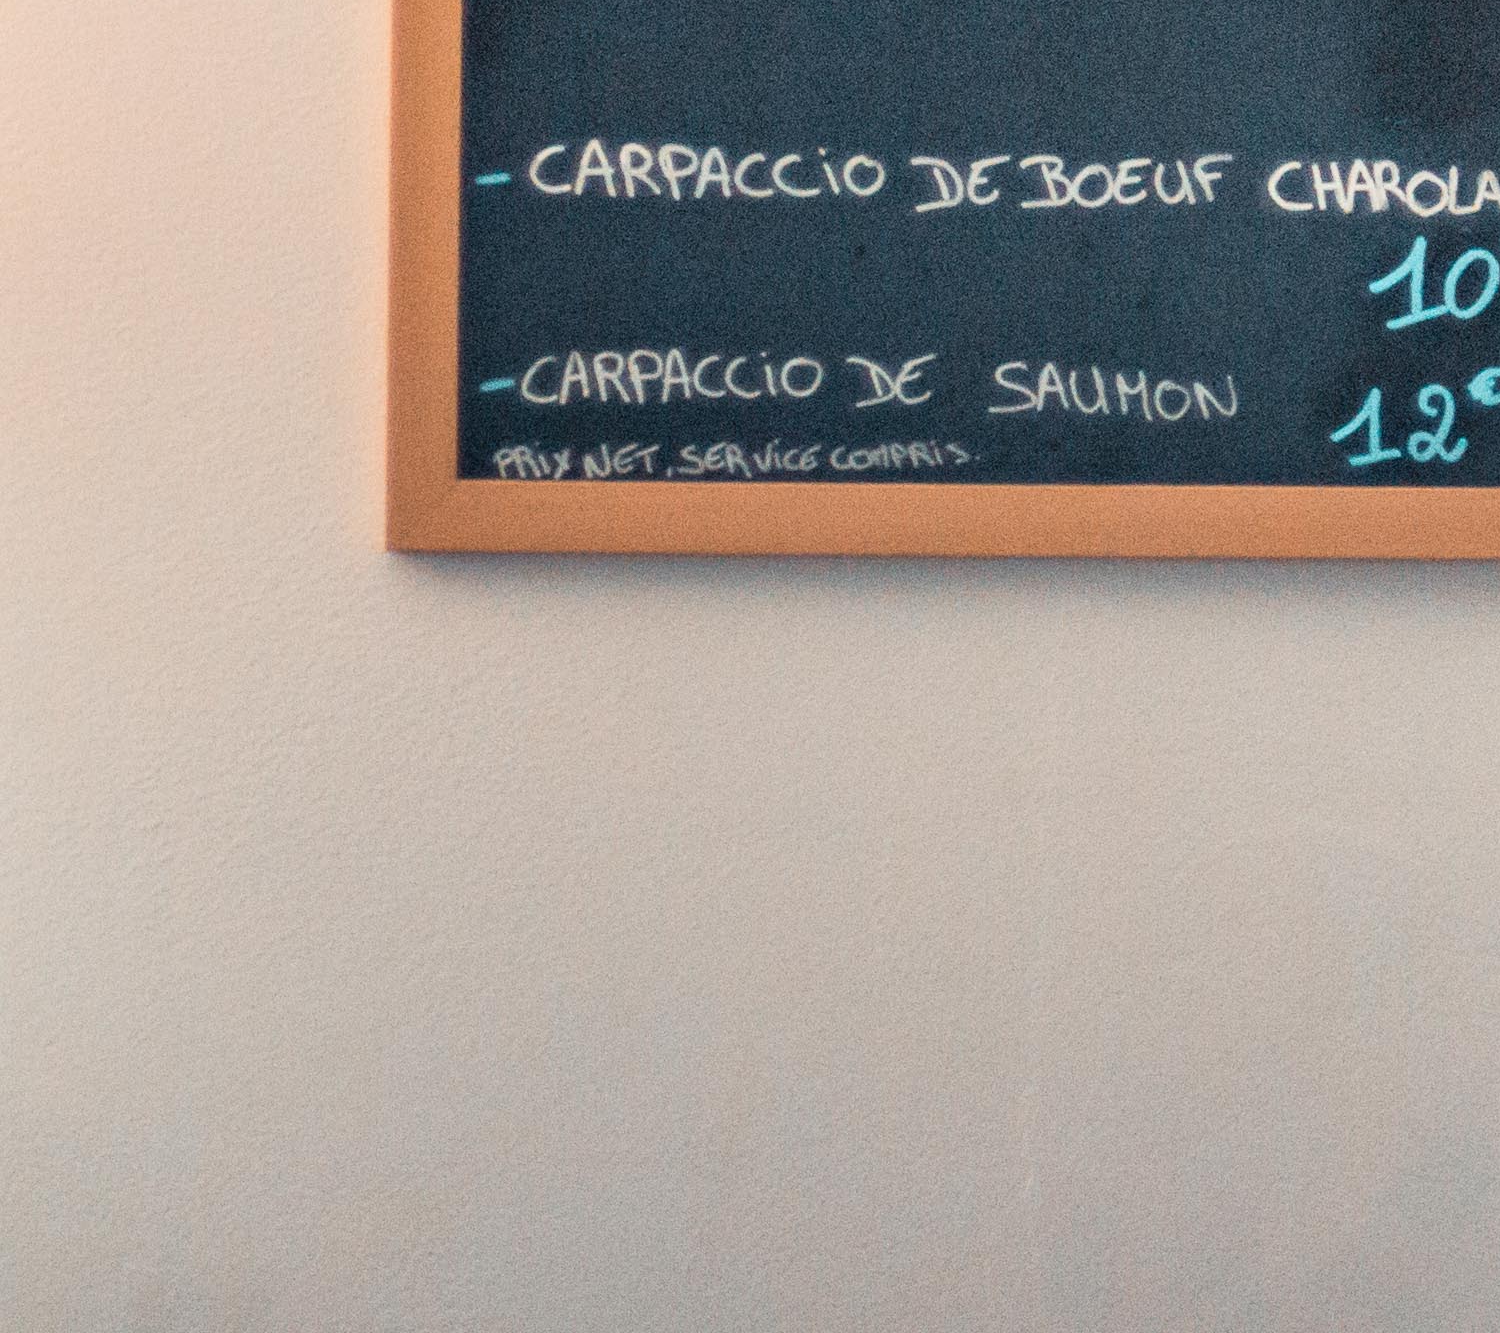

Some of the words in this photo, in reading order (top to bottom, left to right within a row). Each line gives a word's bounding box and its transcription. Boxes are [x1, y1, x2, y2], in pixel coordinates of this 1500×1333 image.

[910, 154, 1011, 213] DE
[1019, 153, 1233, 209] BOEUF
[848, 353, 935, 407] DE
[989, 361, 1238, 421] SAUMON
